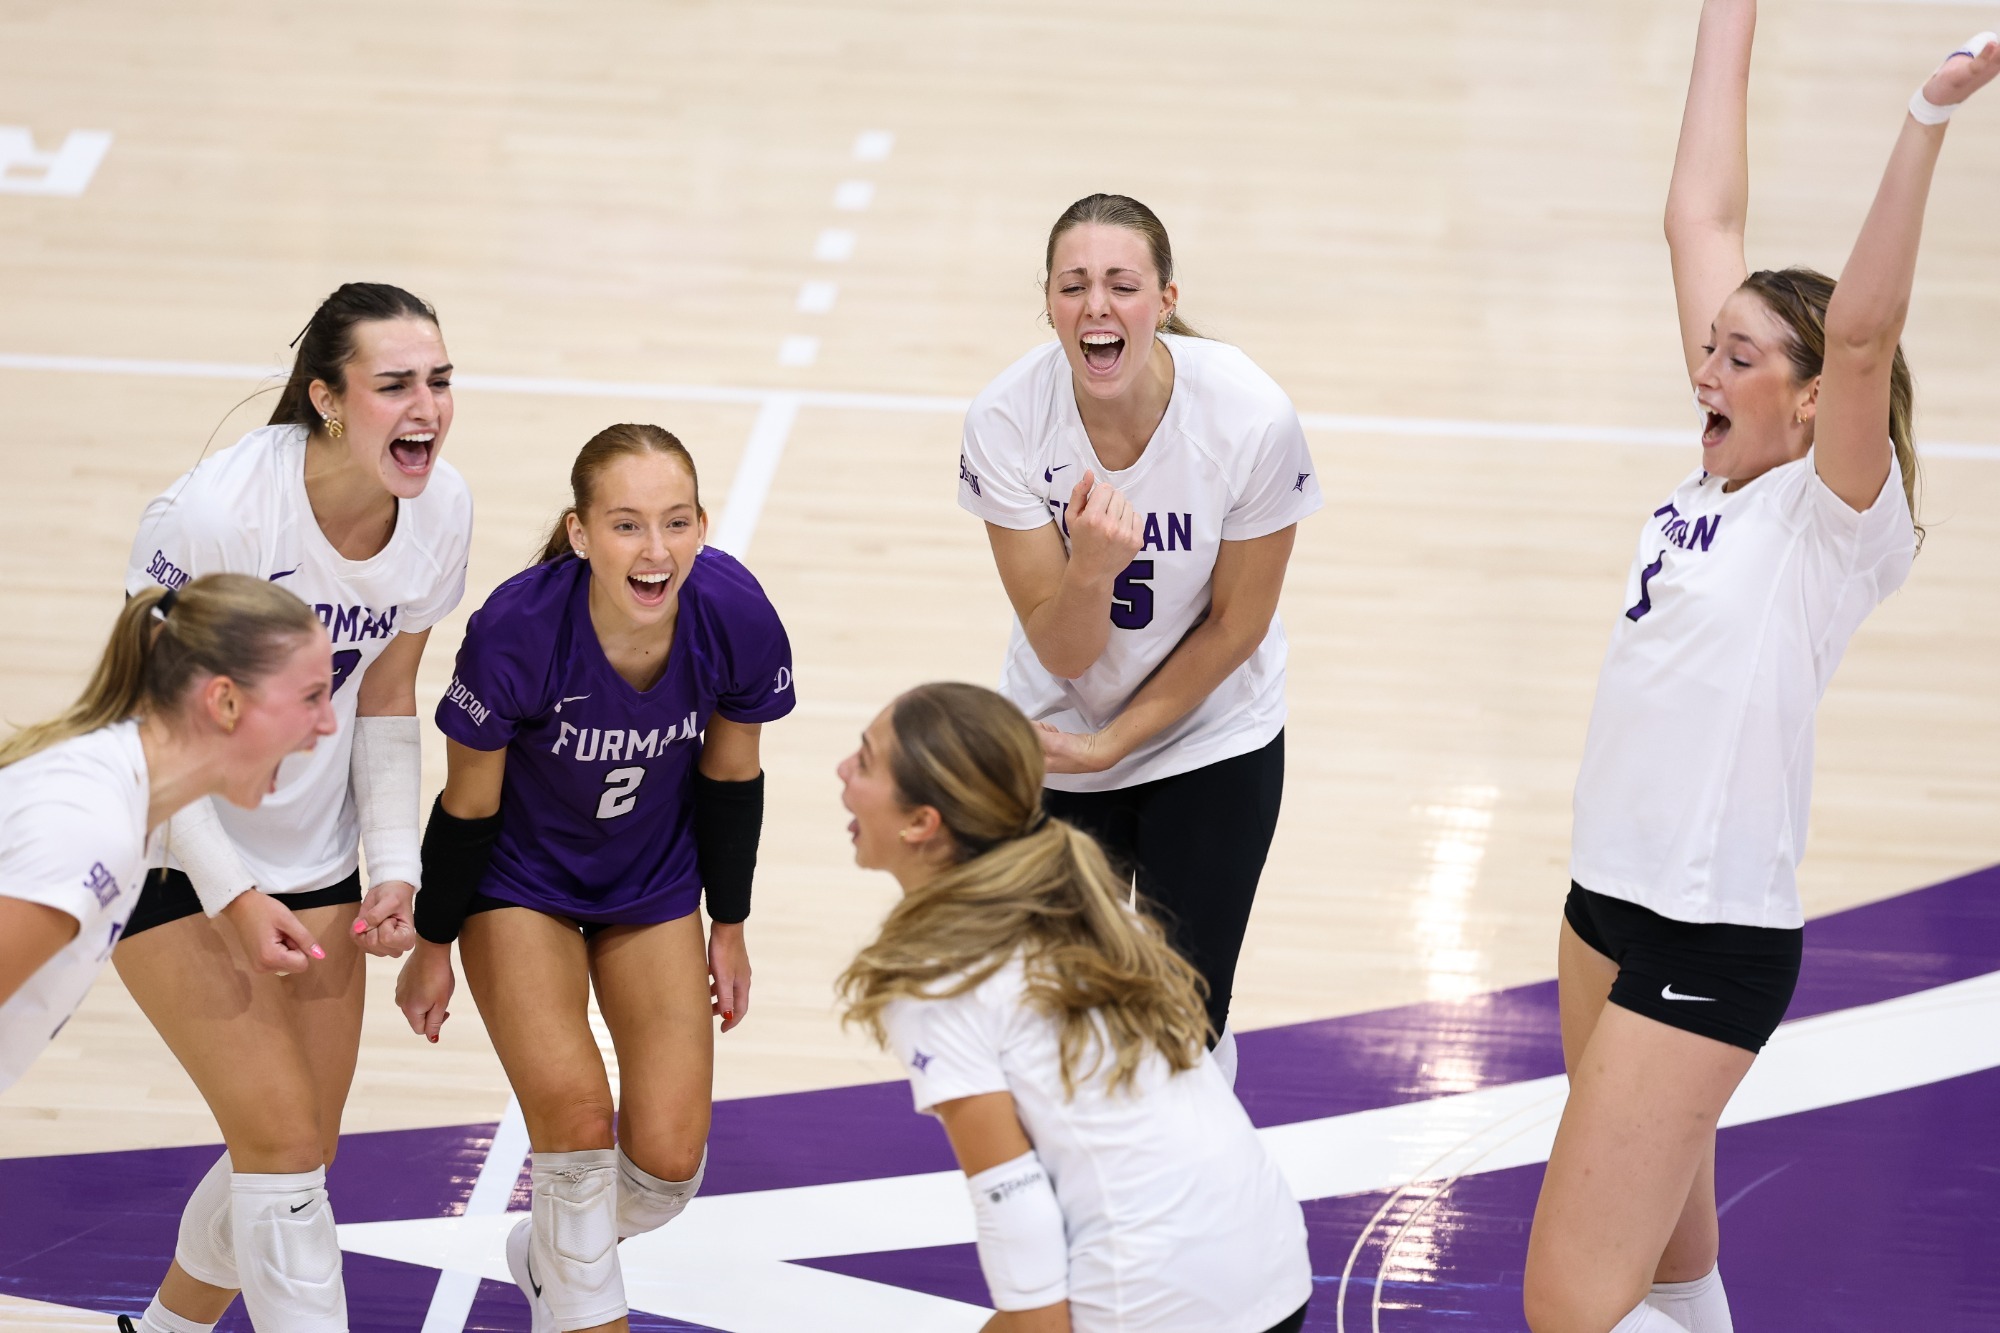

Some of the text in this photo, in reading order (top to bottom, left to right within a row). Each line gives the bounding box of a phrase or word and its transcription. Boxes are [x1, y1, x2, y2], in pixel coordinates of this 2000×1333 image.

[146, 549, 192, 592] SOCON
[1110, 559, 1154, 630] 5
[445, 674, 491, 727] SOCON
[551, 711, 698, 762] FURMAN
[595, 765, 646, 820] 2
